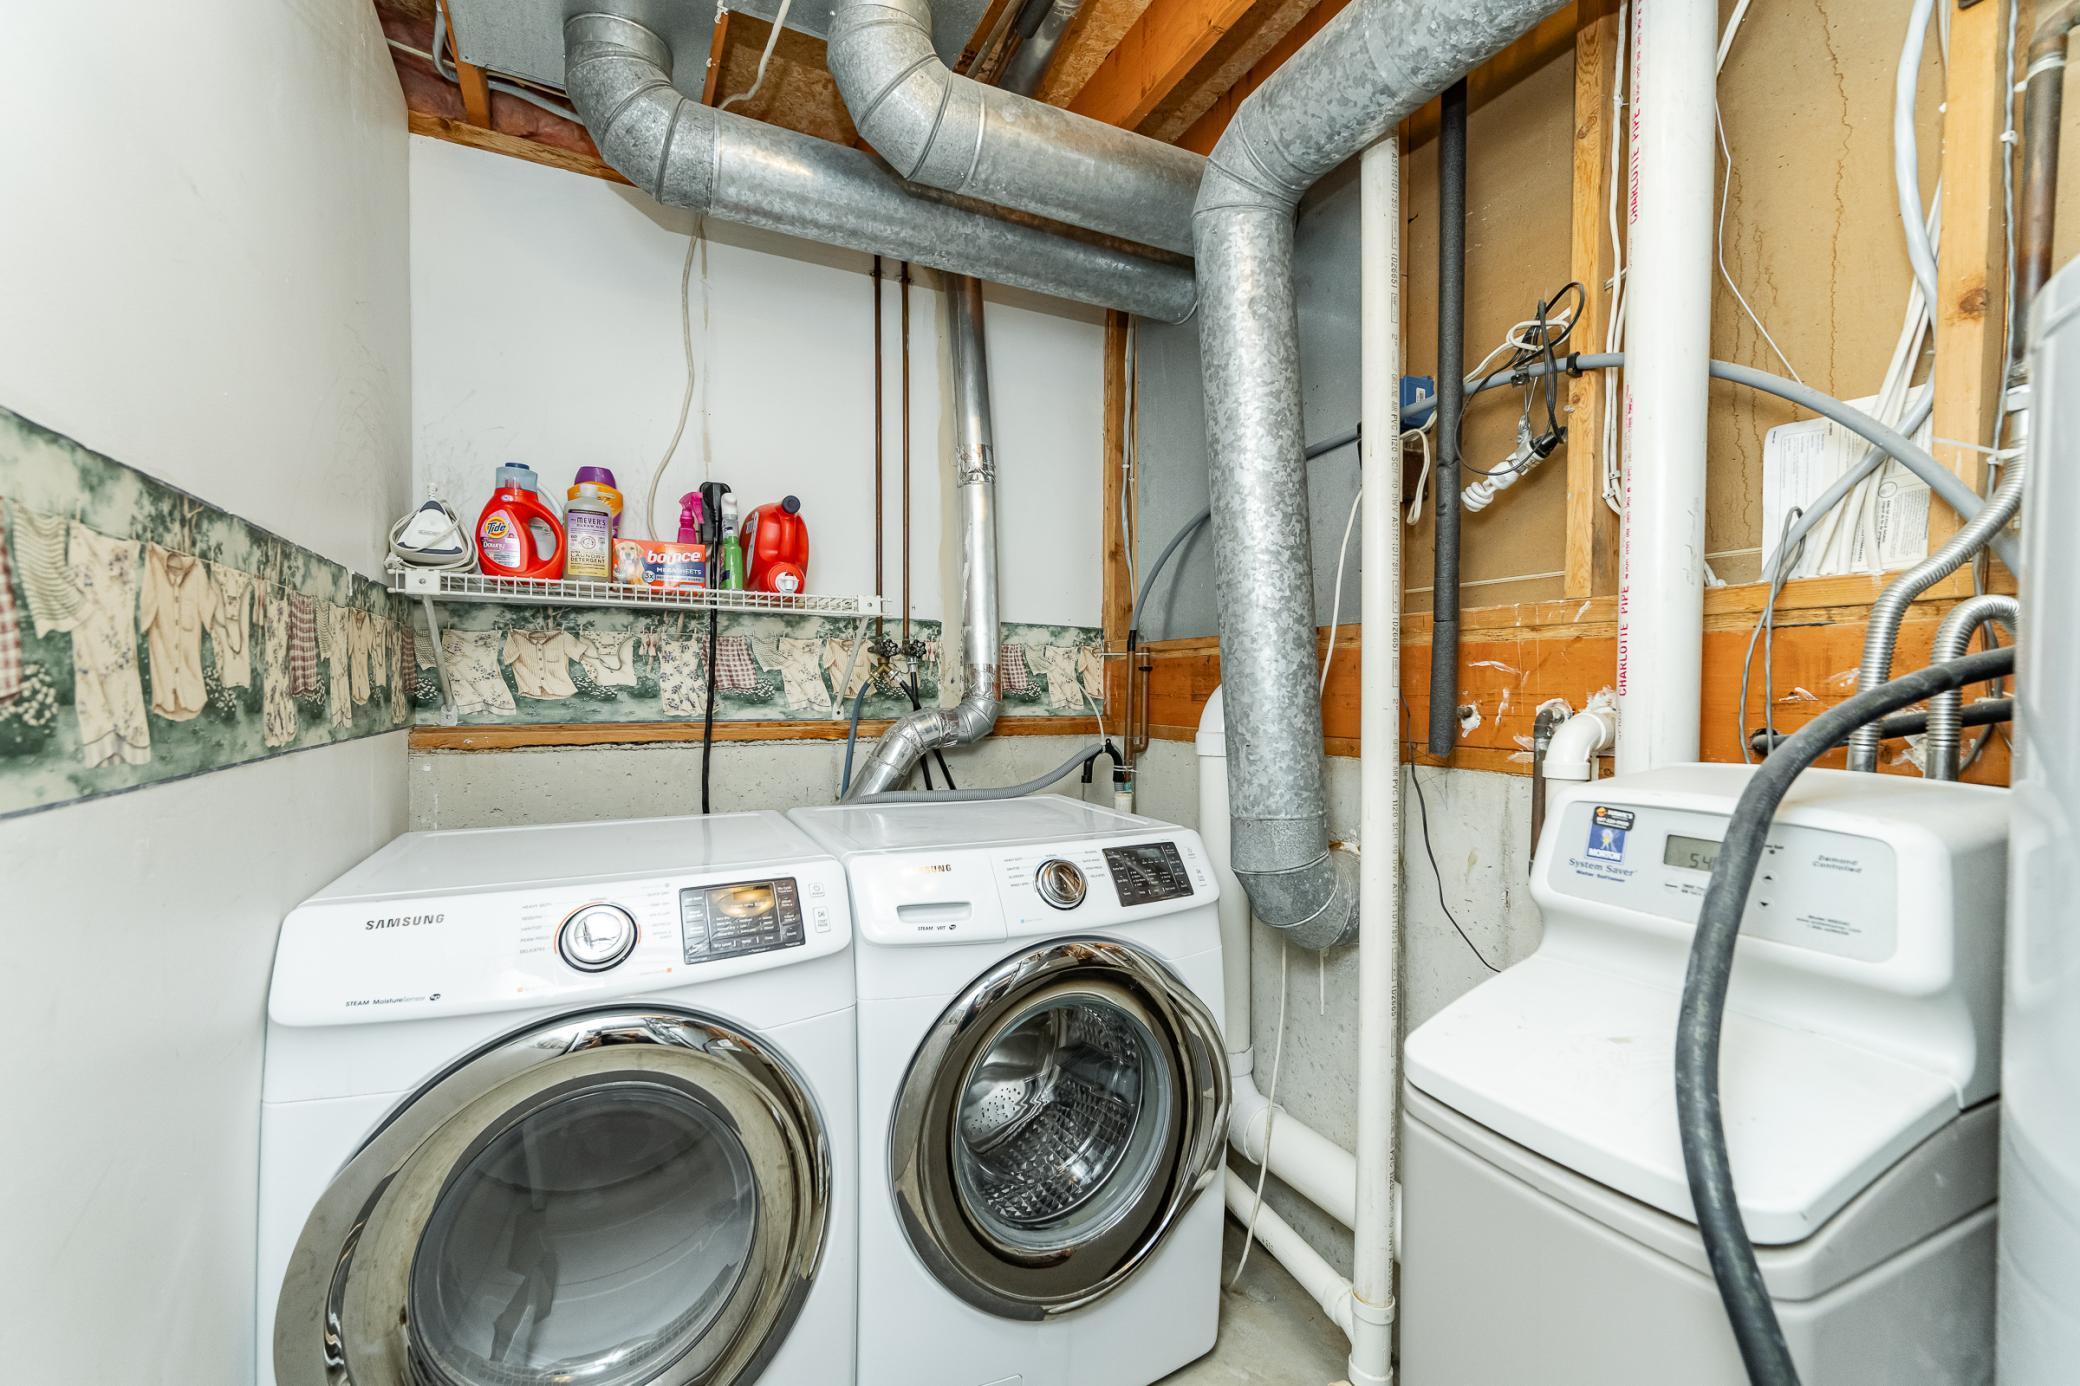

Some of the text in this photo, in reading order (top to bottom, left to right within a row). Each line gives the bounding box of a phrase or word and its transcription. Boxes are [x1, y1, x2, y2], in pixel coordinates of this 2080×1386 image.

[1631, 108, 1640, 142] PIPE
[1630, 146, 1640, 226] CHARLOTTE
[488, 522, 506, 534] Tide
[1620, 586, 1629, 614] PIPE
[1618, 623, 1628, 696] CHARLOTTE
[1569, 857, 1633, 876] System Saver
[1818, 855, 1858, 866] Demand
[365, 914, 445, 930] SAMSUNG
